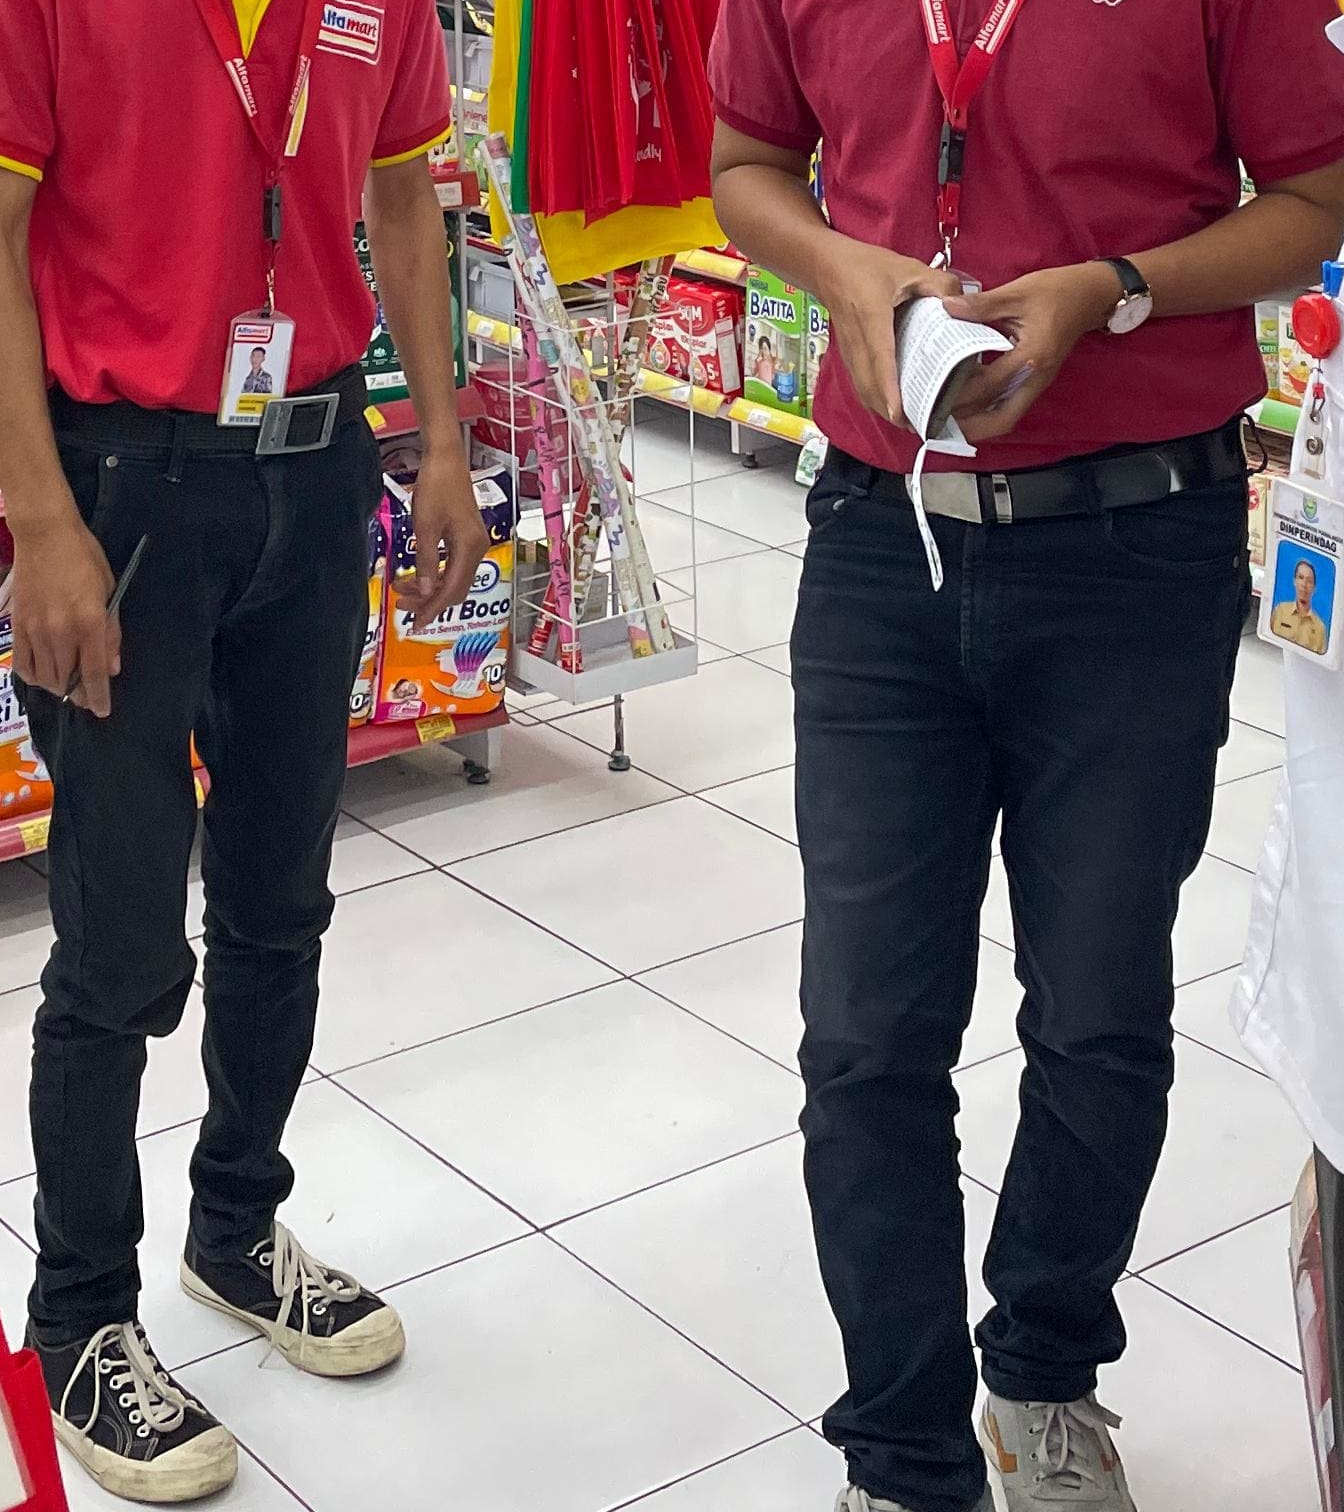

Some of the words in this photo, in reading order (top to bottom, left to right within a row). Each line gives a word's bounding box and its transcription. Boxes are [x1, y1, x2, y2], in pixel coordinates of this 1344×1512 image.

[232, 57, 259, 116] Alfamart
[749, 291, 795, 321] BATITA
[1279, 521, 1338, 553] DINPERINDAG
